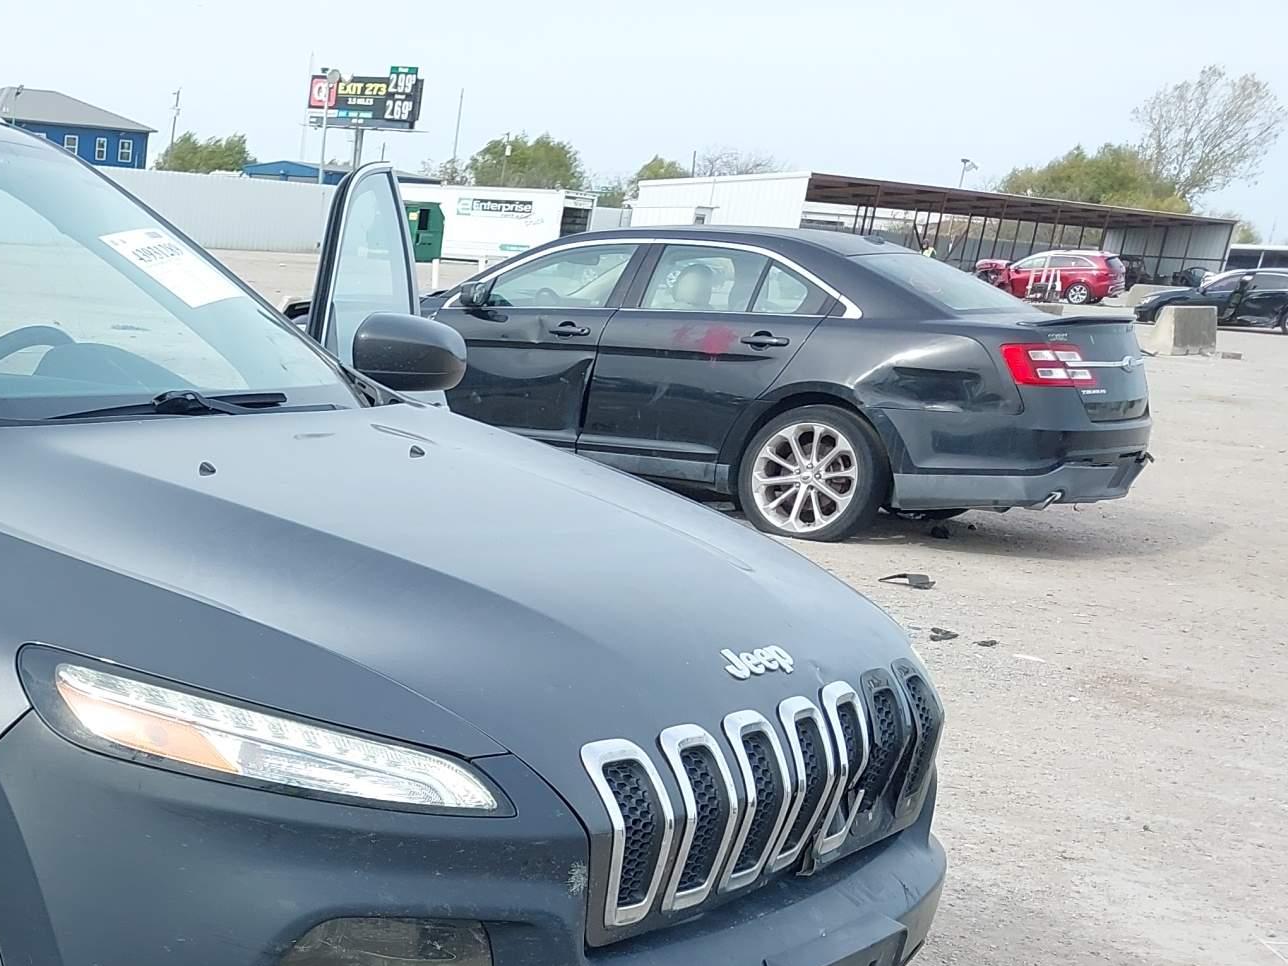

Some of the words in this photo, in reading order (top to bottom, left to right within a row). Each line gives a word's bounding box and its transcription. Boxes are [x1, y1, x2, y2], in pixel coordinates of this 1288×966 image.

[338, 82, 364, 94] EXIT
[364, 83, 387, 95] 273
[473, 200, 532, 213] Enterprise
[720, 645, 794, 680] Jeep
